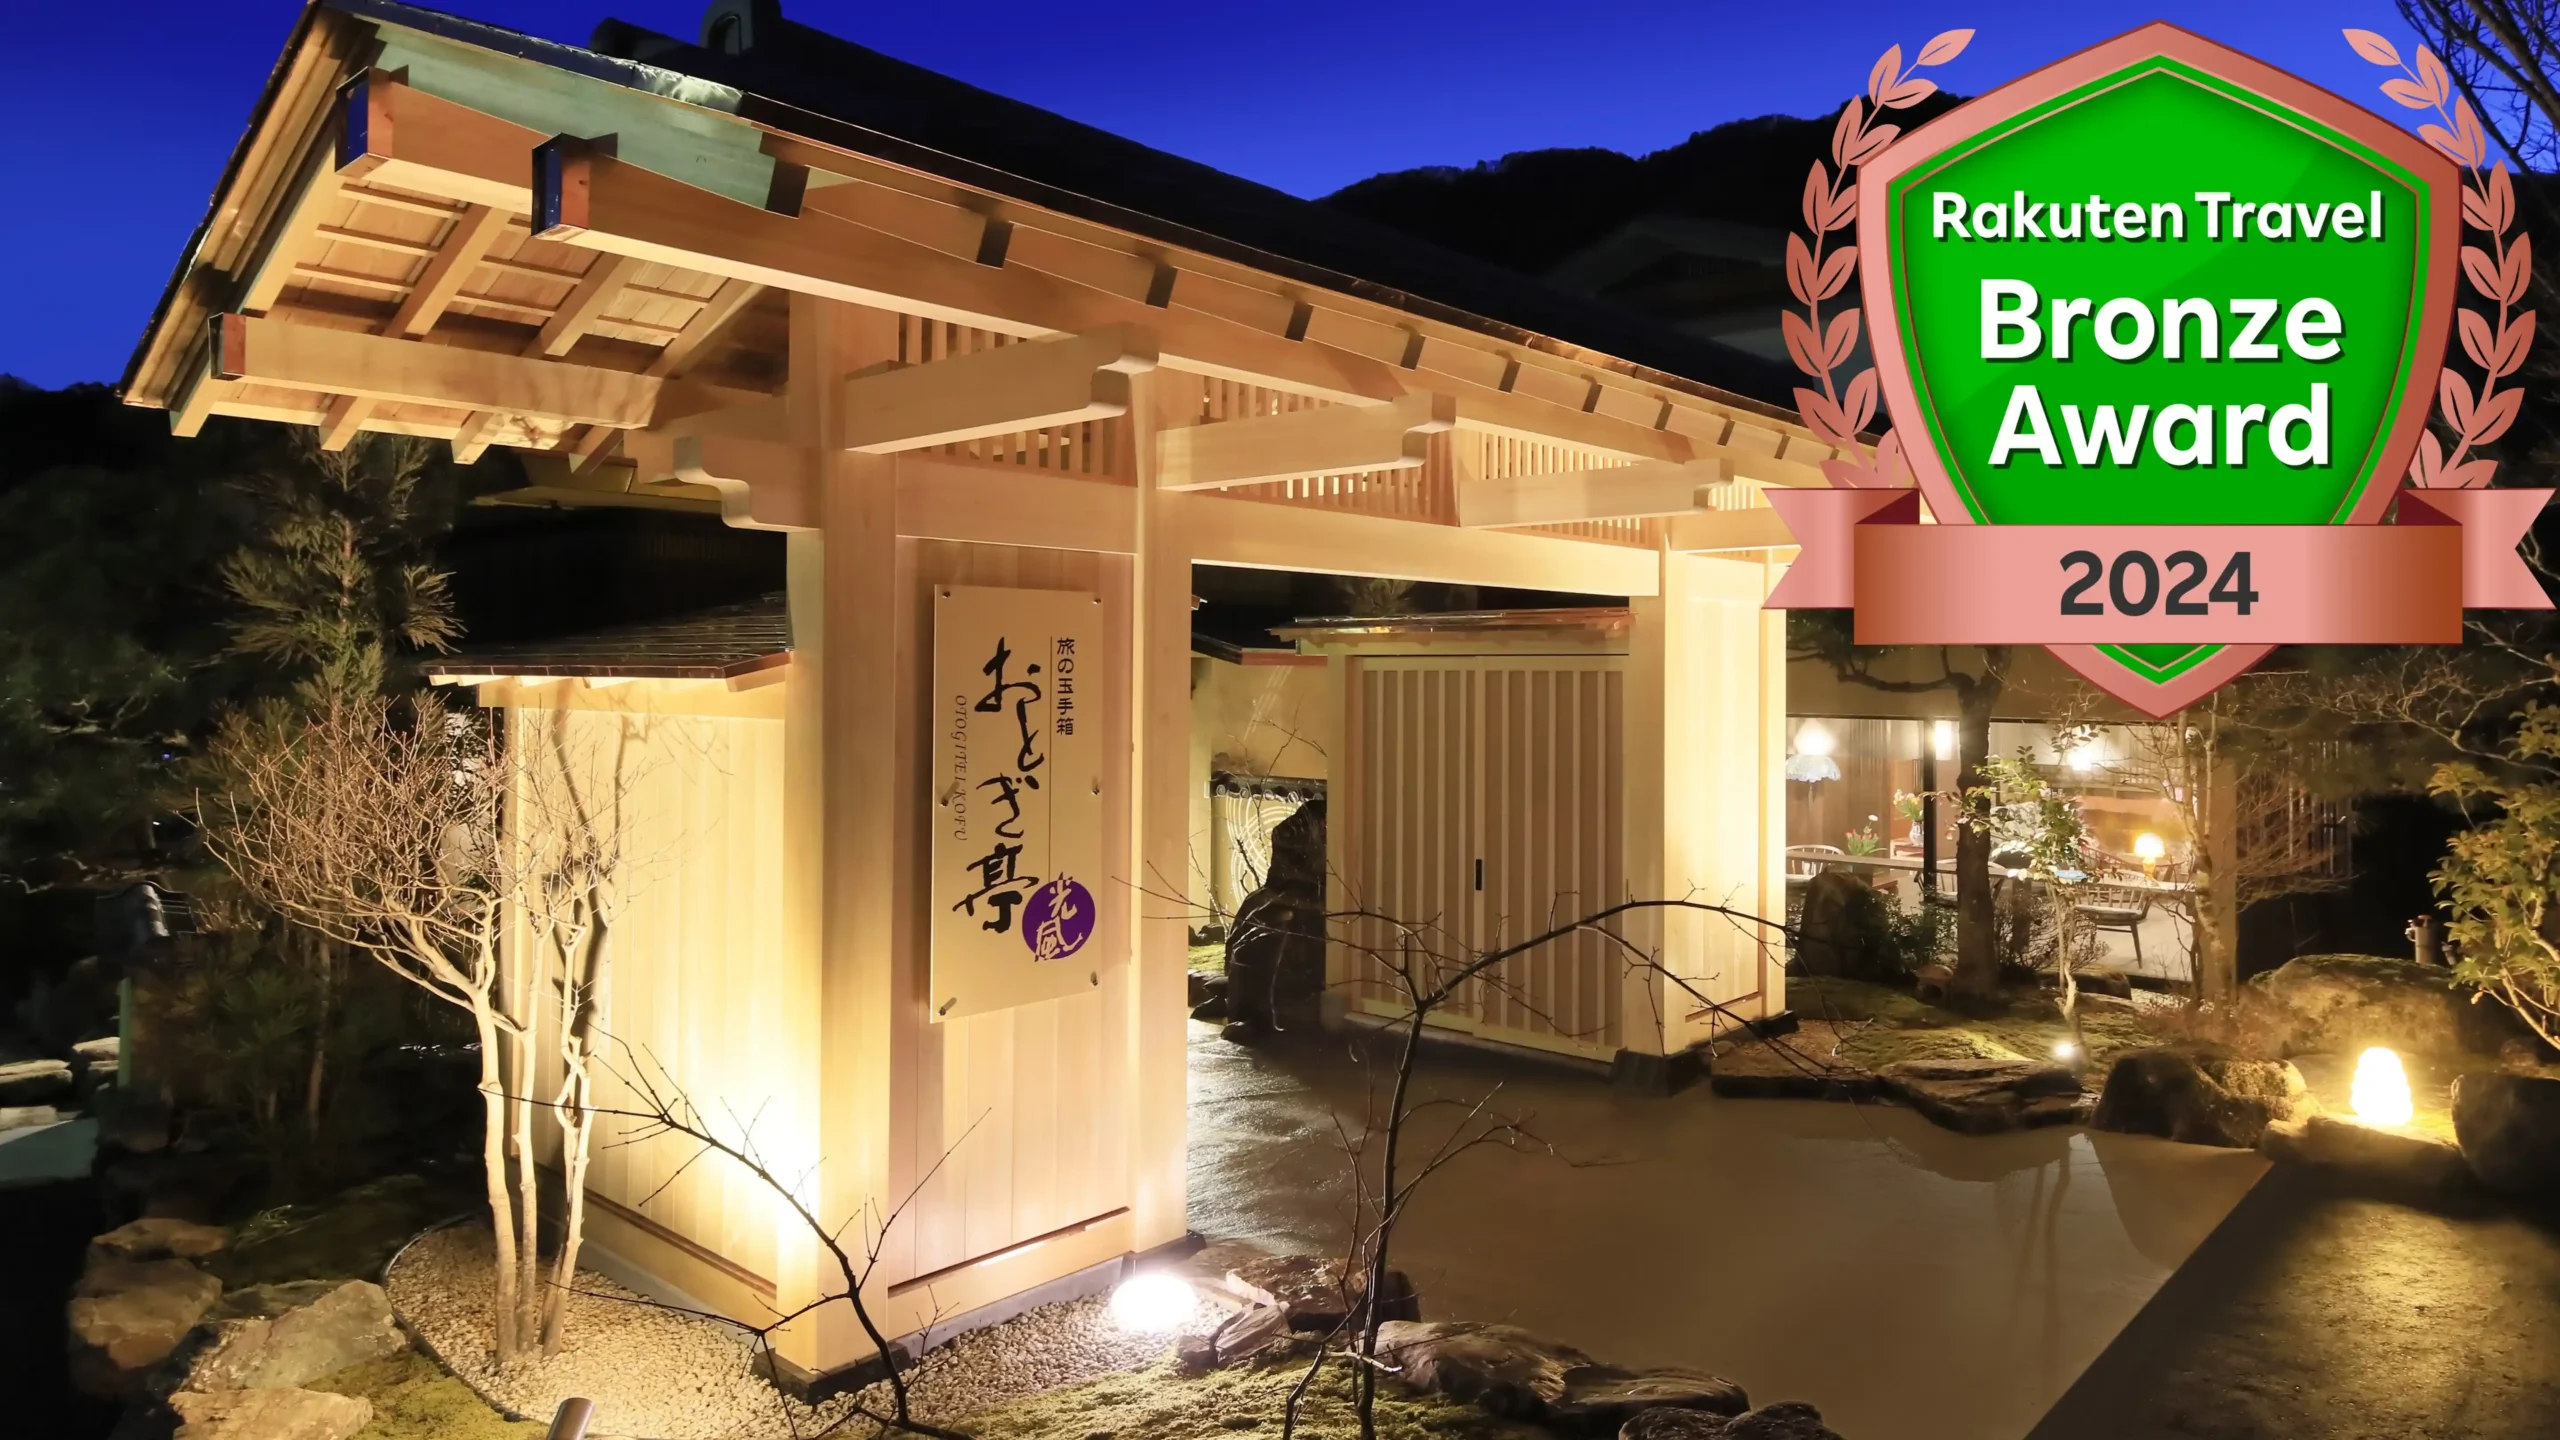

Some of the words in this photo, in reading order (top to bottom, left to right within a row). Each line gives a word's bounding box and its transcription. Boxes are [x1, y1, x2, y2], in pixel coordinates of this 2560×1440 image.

[1056, 637, 1076, 736] 旅の玉手箱
[951, 694, 968, 782] OTOGITEI
[952, 636, 1041, 933] おとぎ亭
[952, 788, 968, 841] KOFU
[1034, 871, 1083, 962] 光風
